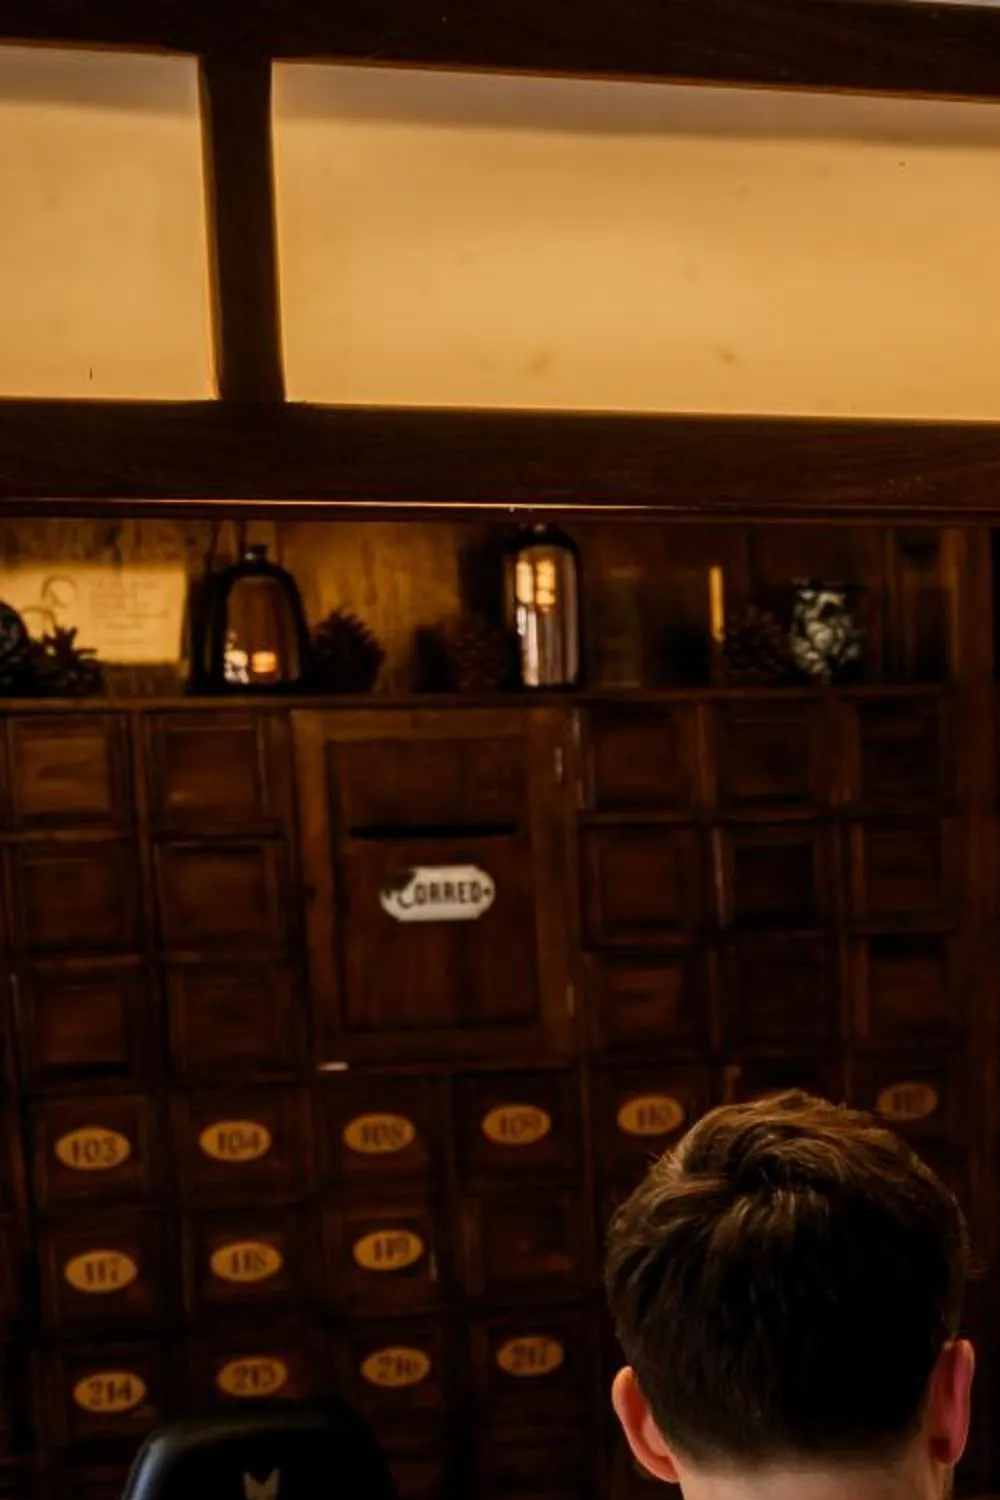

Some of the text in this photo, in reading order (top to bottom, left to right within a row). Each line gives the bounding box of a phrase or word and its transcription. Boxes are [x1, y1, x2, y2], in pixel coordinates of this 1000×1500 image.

[71, 1137, 118, 1163] 103
[217, 1130, 260, 1156] 104
[88, 1380, 132, 1405] 214
